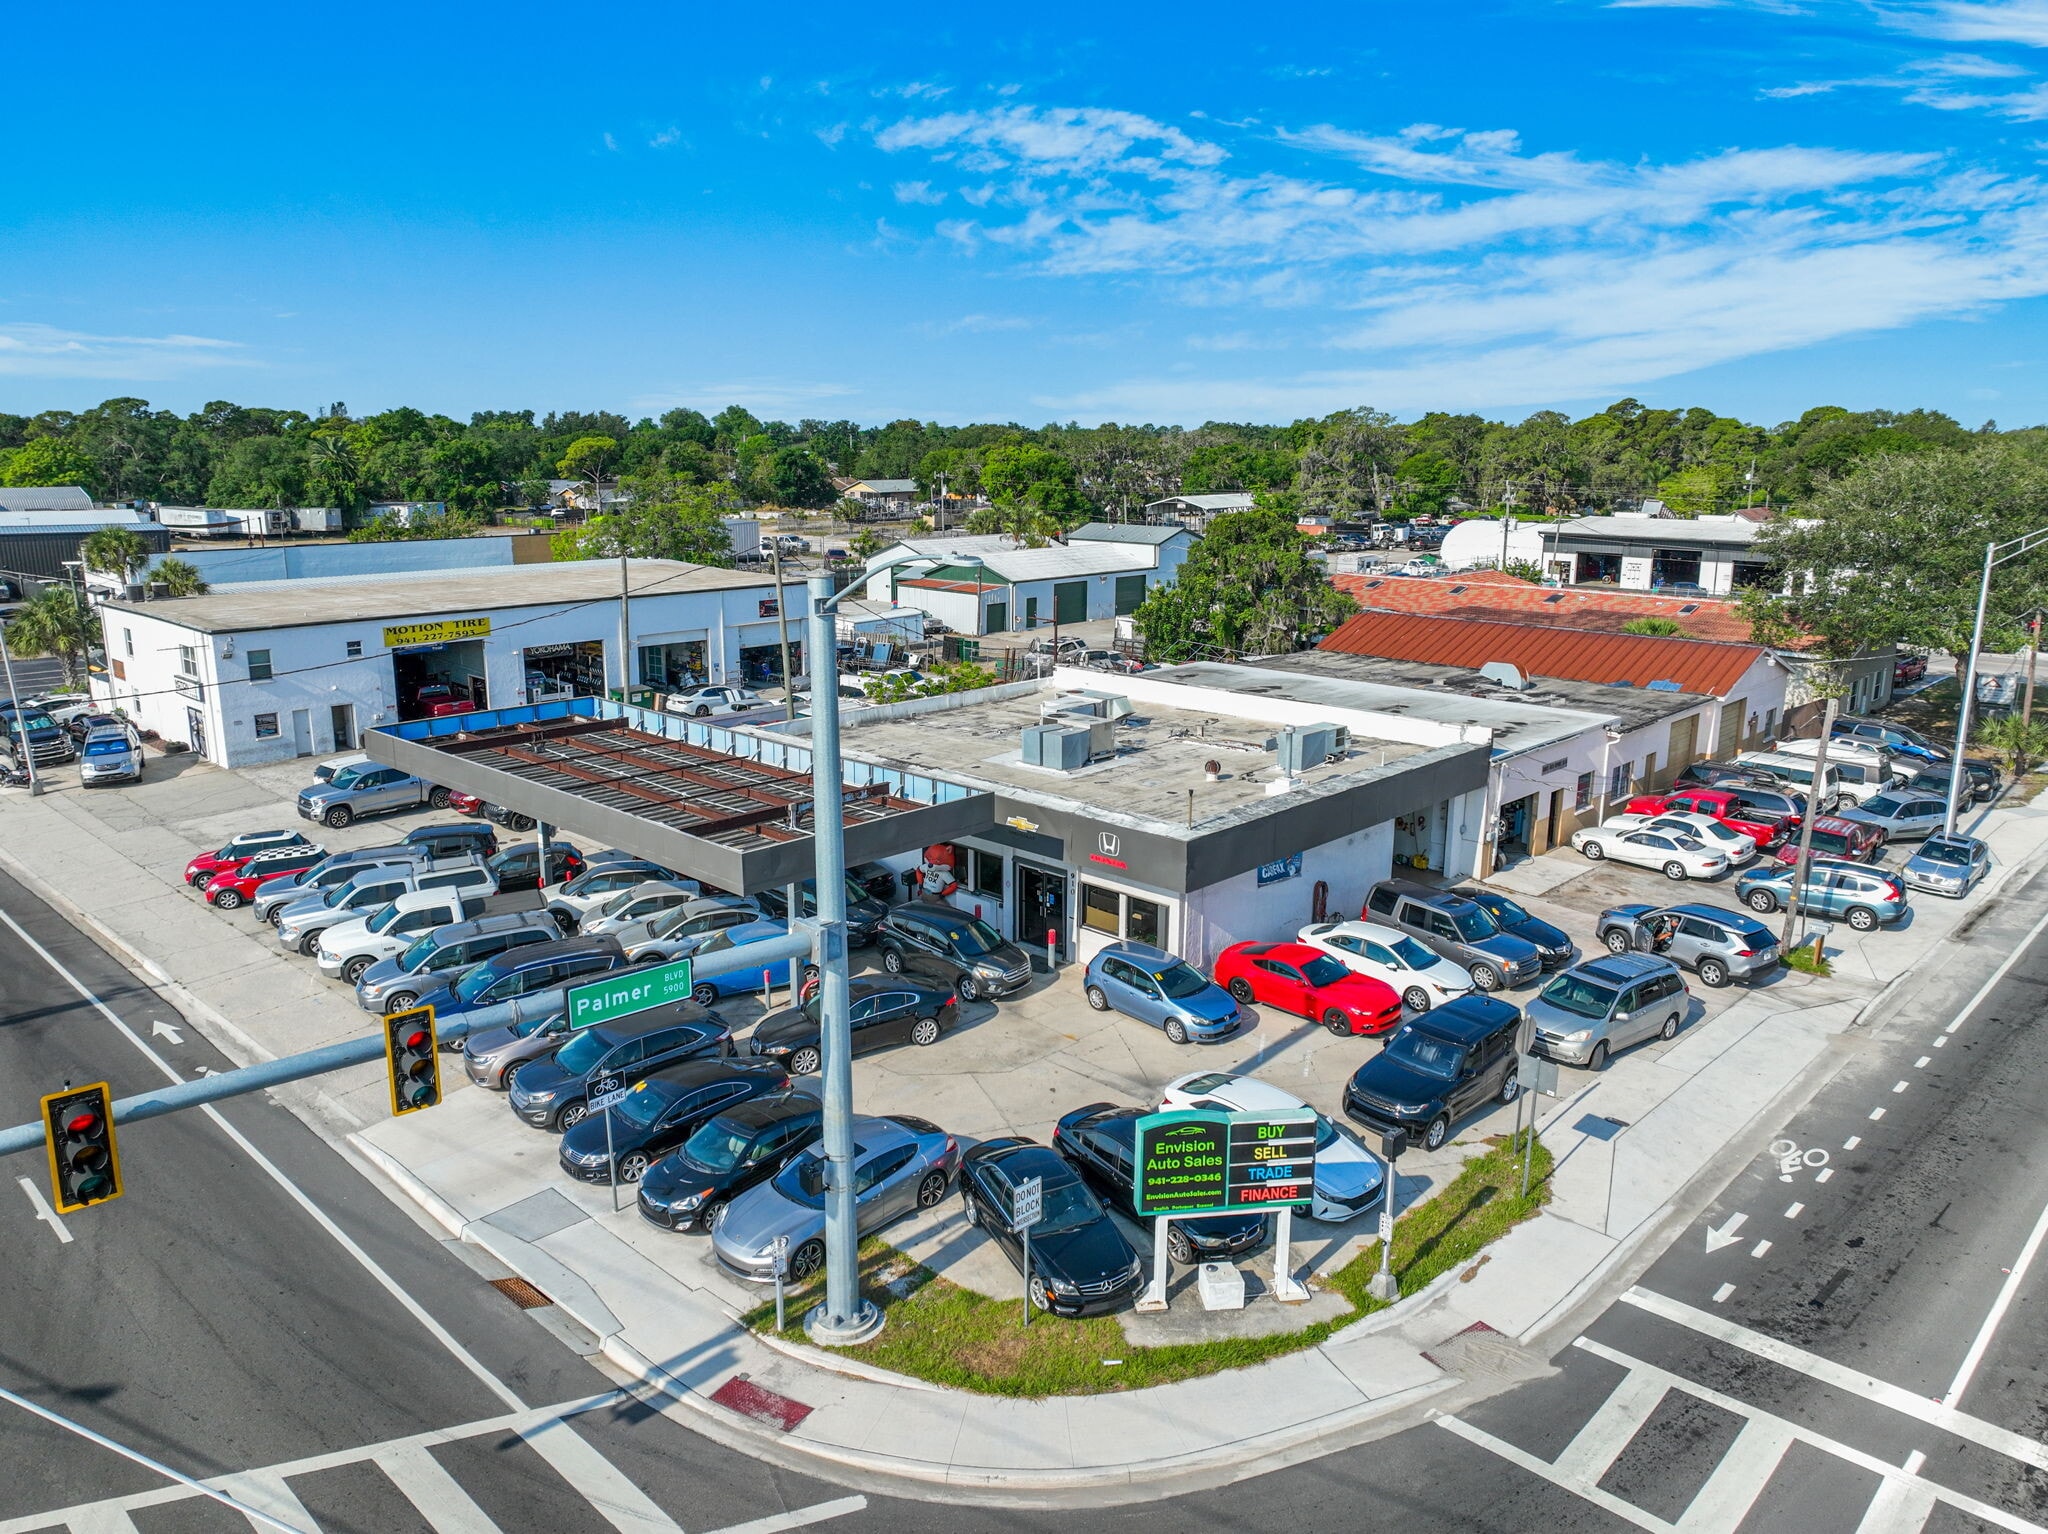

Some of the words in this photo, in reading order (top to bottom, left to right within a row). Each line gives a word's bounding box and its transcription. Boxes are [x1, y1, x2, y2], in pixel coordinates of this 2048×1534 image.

[386, 622, 443, 636] MOTION
[453, 618, 486, 629] TIRE
[396, 630, 475, 645] 941-227-7593
[530, 643, 571, 654] YOKOHAMA
[1262, 862, 1286, 878] CARFAX
[664, 969, 684, 982] BLVD
[663, 983, 684, 995] 5900
[577, 984, 652, 1016] Palmer
[590, 1098, 605, 1110] BIKE
[607, 1091, 625, 1103] LANE
[1258, 1125, 1286, 1139] BUY
[1155, 1140, 1215, 1155] Envision
[1254, 1146, 1288, 1160] SELL
[1146, 1157, 1182, 1171] Auto
[1183, 1155, 1223, 1168] Sales
[1147, 1173, 1221, 1186] 941-228-0346
[1248, 1166, 1293, 1180] TRADE
[1016, 1191, 1026, 1203] DO
[1026, 1183, 1040, 1198] NOT
[1241, 1186, 1298, 1202] FINANCE
[1016, 1197, 1040, 1217] BLOCK
